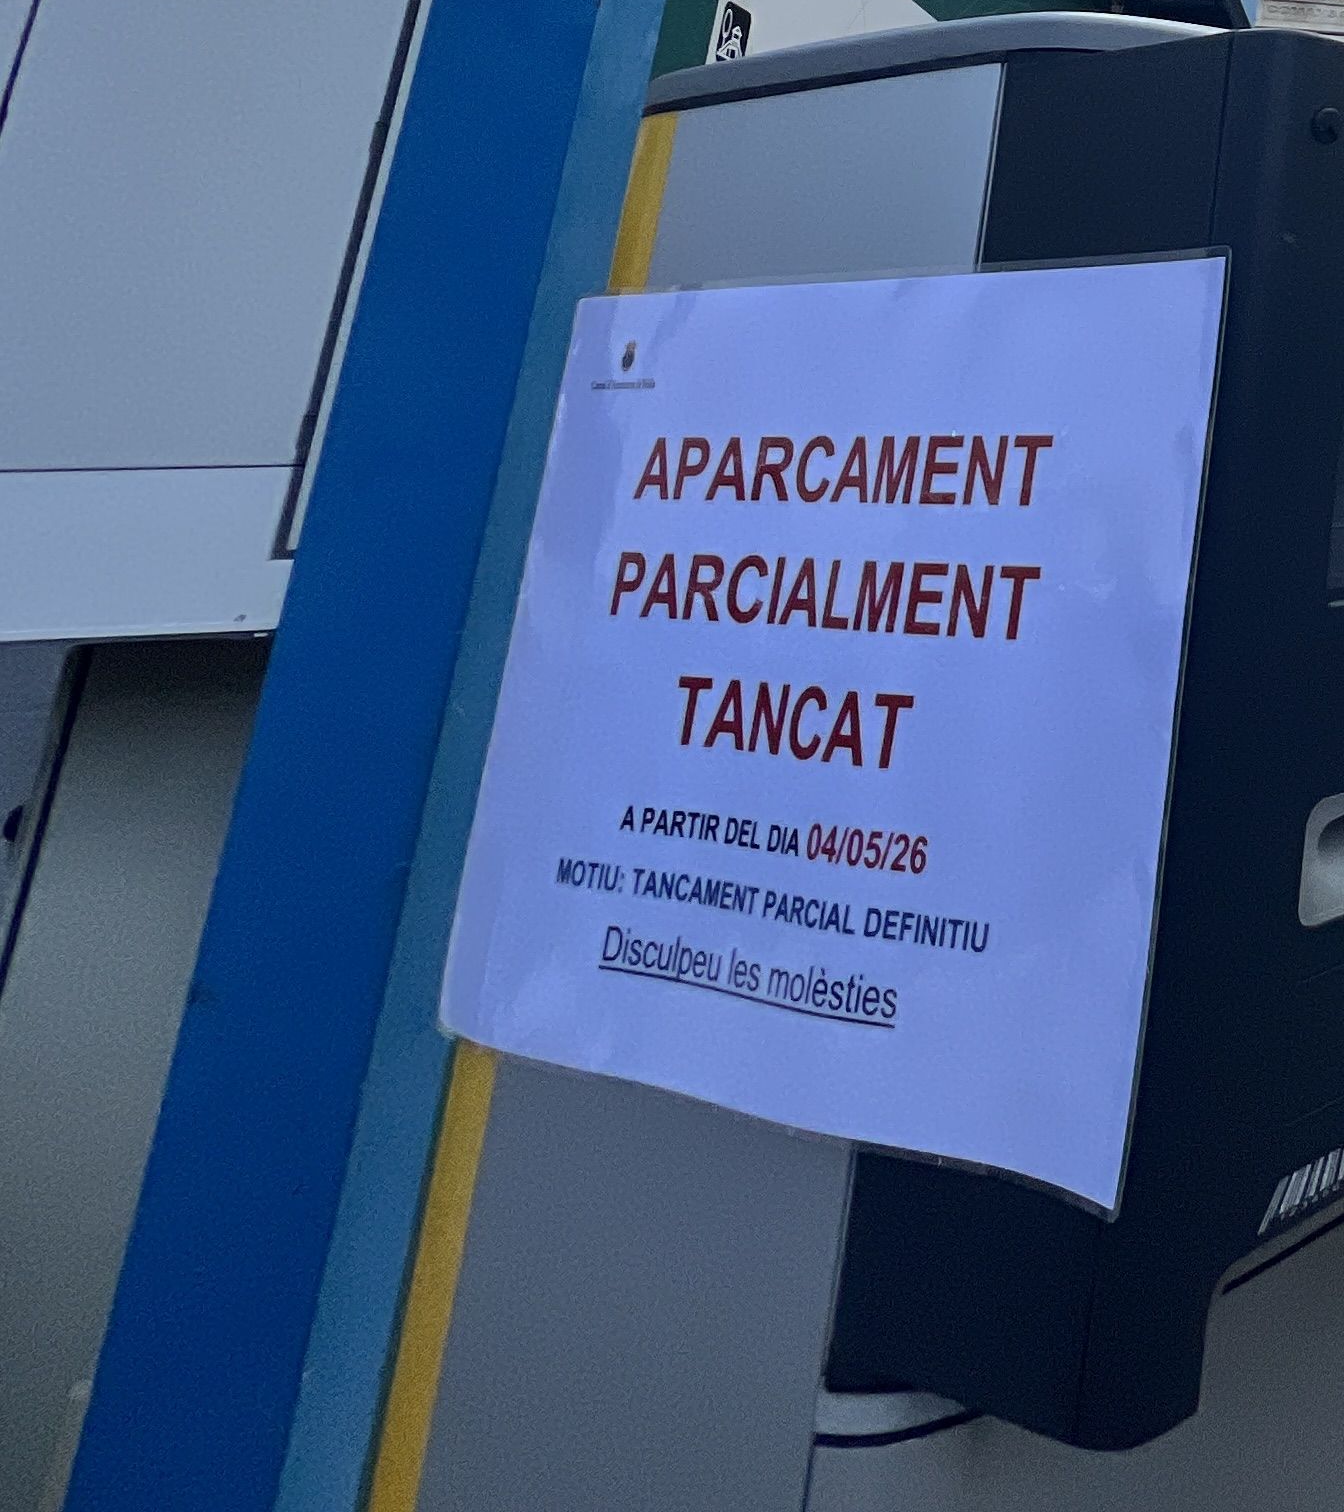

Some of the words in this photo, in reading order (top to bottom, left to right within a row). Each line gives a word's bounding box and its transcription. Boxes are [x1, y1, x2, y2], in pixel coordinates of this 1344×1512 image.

[632, 432, 1053, 508] APARCAMENT
[610, 550, 1041, 642] PARCIALMENT
[676, 675, 915, 770] TANCAT
[619, 805, 635, 831] A
[640, 807, 721, 844] PARTIR
[723, 817, 762, 850] DEL
[766, 824, 799, 857] DIA
[806, 822, 929, 874] 04/05/26
[556, 857, 625, 894] MOTIU:
[631, 867, 760, 916] TANCAMENT
[762, 889, 855, 936] PARCIAL
[863, 908, 990, 954] DEFINITIU
[601, 925, 721, 983] Disculpeu
[728, 947, 761, 991] les
[767, 966, 898, 1020] molèsties
